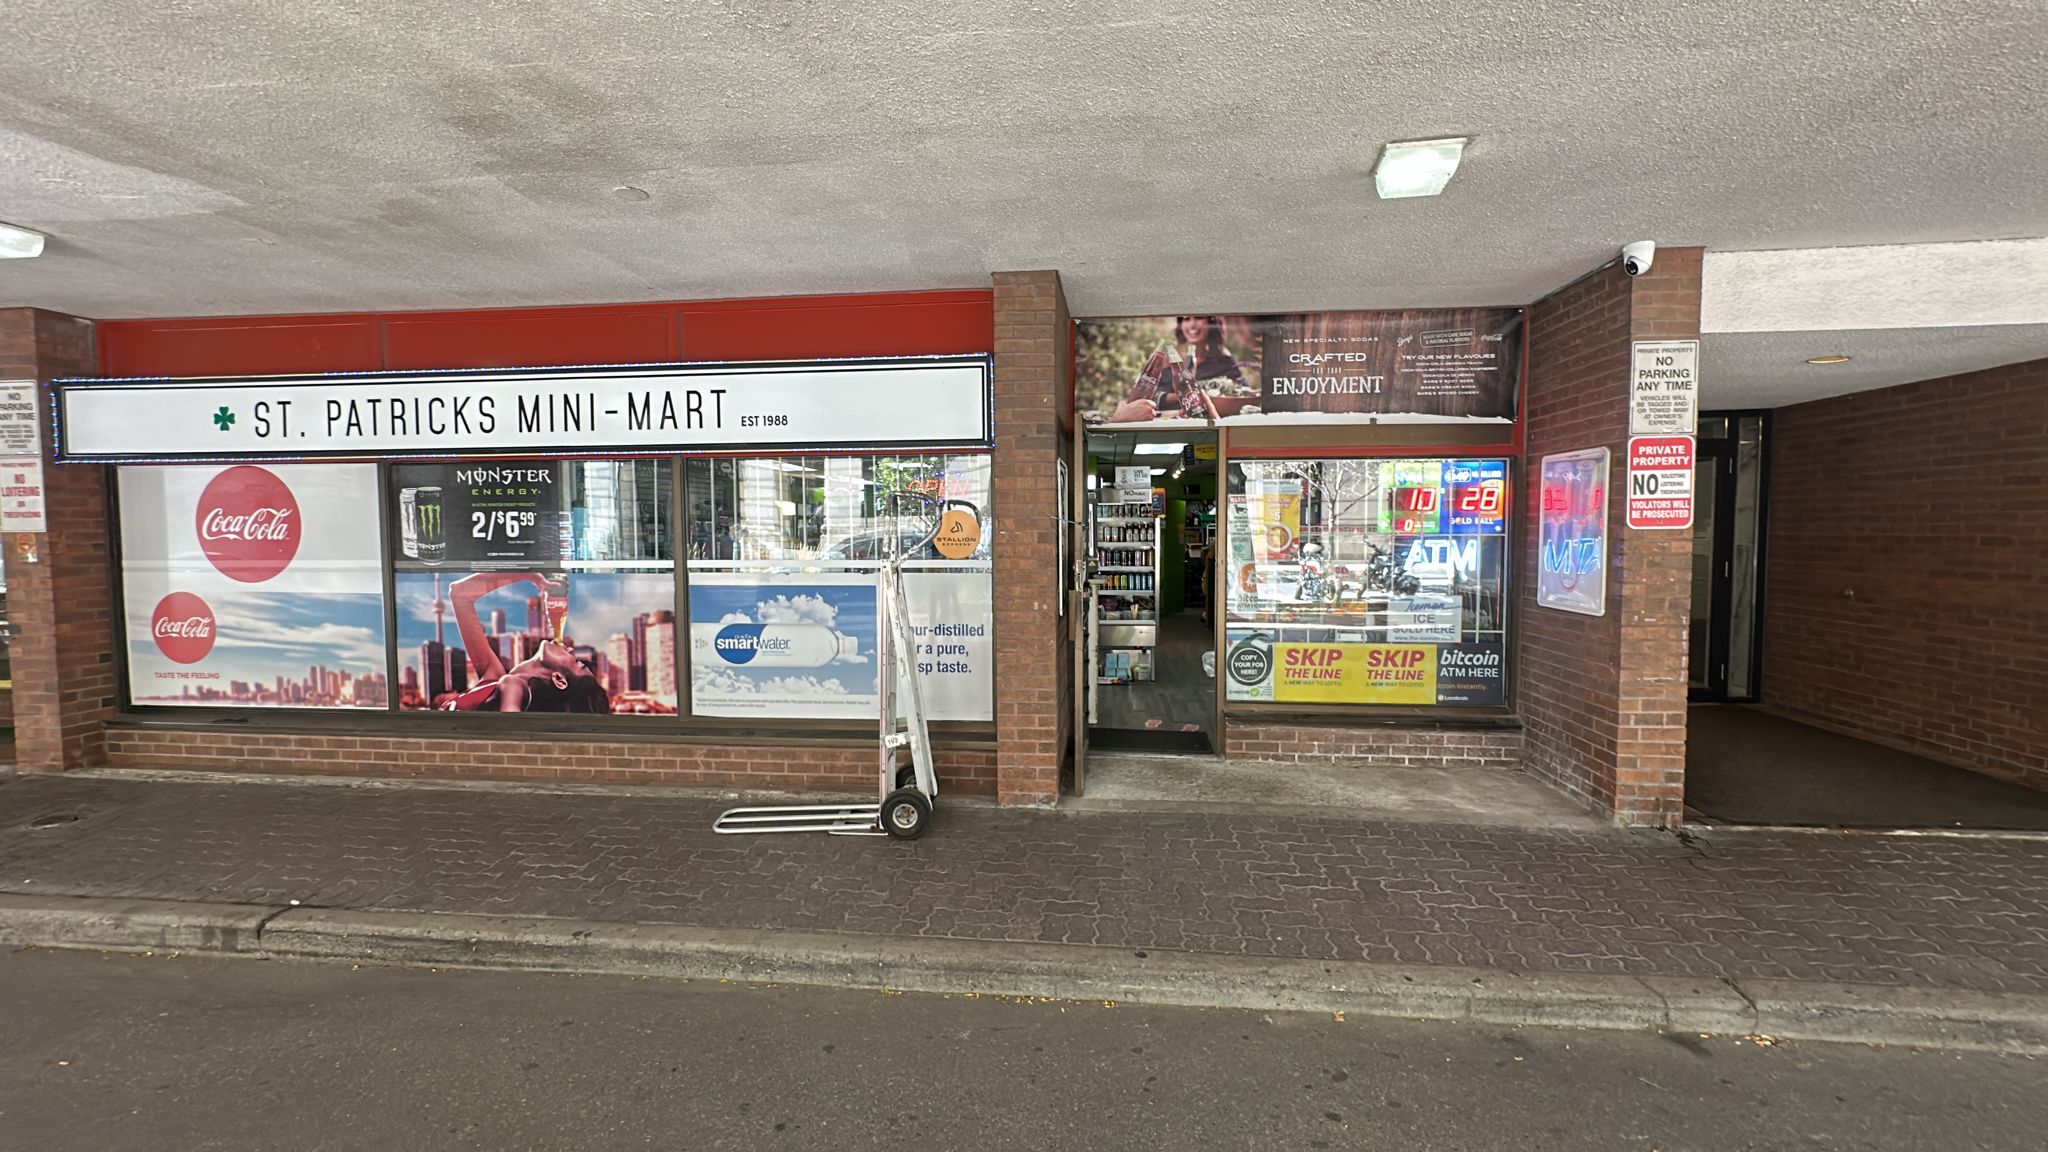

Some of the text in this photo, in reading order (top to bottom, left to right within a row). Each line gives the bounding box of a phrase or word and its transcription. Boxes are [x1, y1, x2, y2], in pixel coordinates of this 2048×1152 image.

[1290, 352, 1366, 366] CRAFTED
[1656, 356, 1674, 366] NO
[1639, 368, 1690, 379] PARKING
[1272, 376, 1384, 395] ENJOYMENT
[1636, 381, 1692, 391] ANY TIME
[8, 393, 21, 401] NO
[254, 390, 788, 438] ST. PATRICKS MINI-MART EST 1988
[1639, 446, 1686, 454] PRIVATE
[1632, 456, 1690, 466] PROPERTY
[456, 467, 552, 486] MONSTER
[1633, 474, 1658, 496] NO
[472, 488, 538, 496] ENERGY
[1410, 488, 1436, 510] 10
[1462, 488, 1499, 510] 28
[1632, 500, 1690, 509] VIOLATORS WILL
[1632, 510, 1689, 518] BE PROSECUTED
[202, 507, 292, 541] Coca-Cola
[1403, 540, 1477, 572] ATM
[1414, 614, 1436, 624] ICE
[155, 616, 212, 638] Coca-Cola
[909, 624, 984, 637] ur-distilled
[1426, 625, 1455, 634] HERE
[716, 636, 790, 650] smartwater
[925, 645, 932, 654] a
[937, 644, 969, 657] pure,
[1285, 648, 1343, 666] SKIP
[1368, 649, 1425, 668] SKIP
[1440, 650, 1500, 666] bitcoin
[937, 661, 972, 673] taste.
[1440, 668, 1499, 678] ATM HERE
[155, 672, 220, 680] TASTE THE FEELING
[1284, 668, 1342, 679] THE LINE
[1366, 670, 1424, 680] THE LINE
